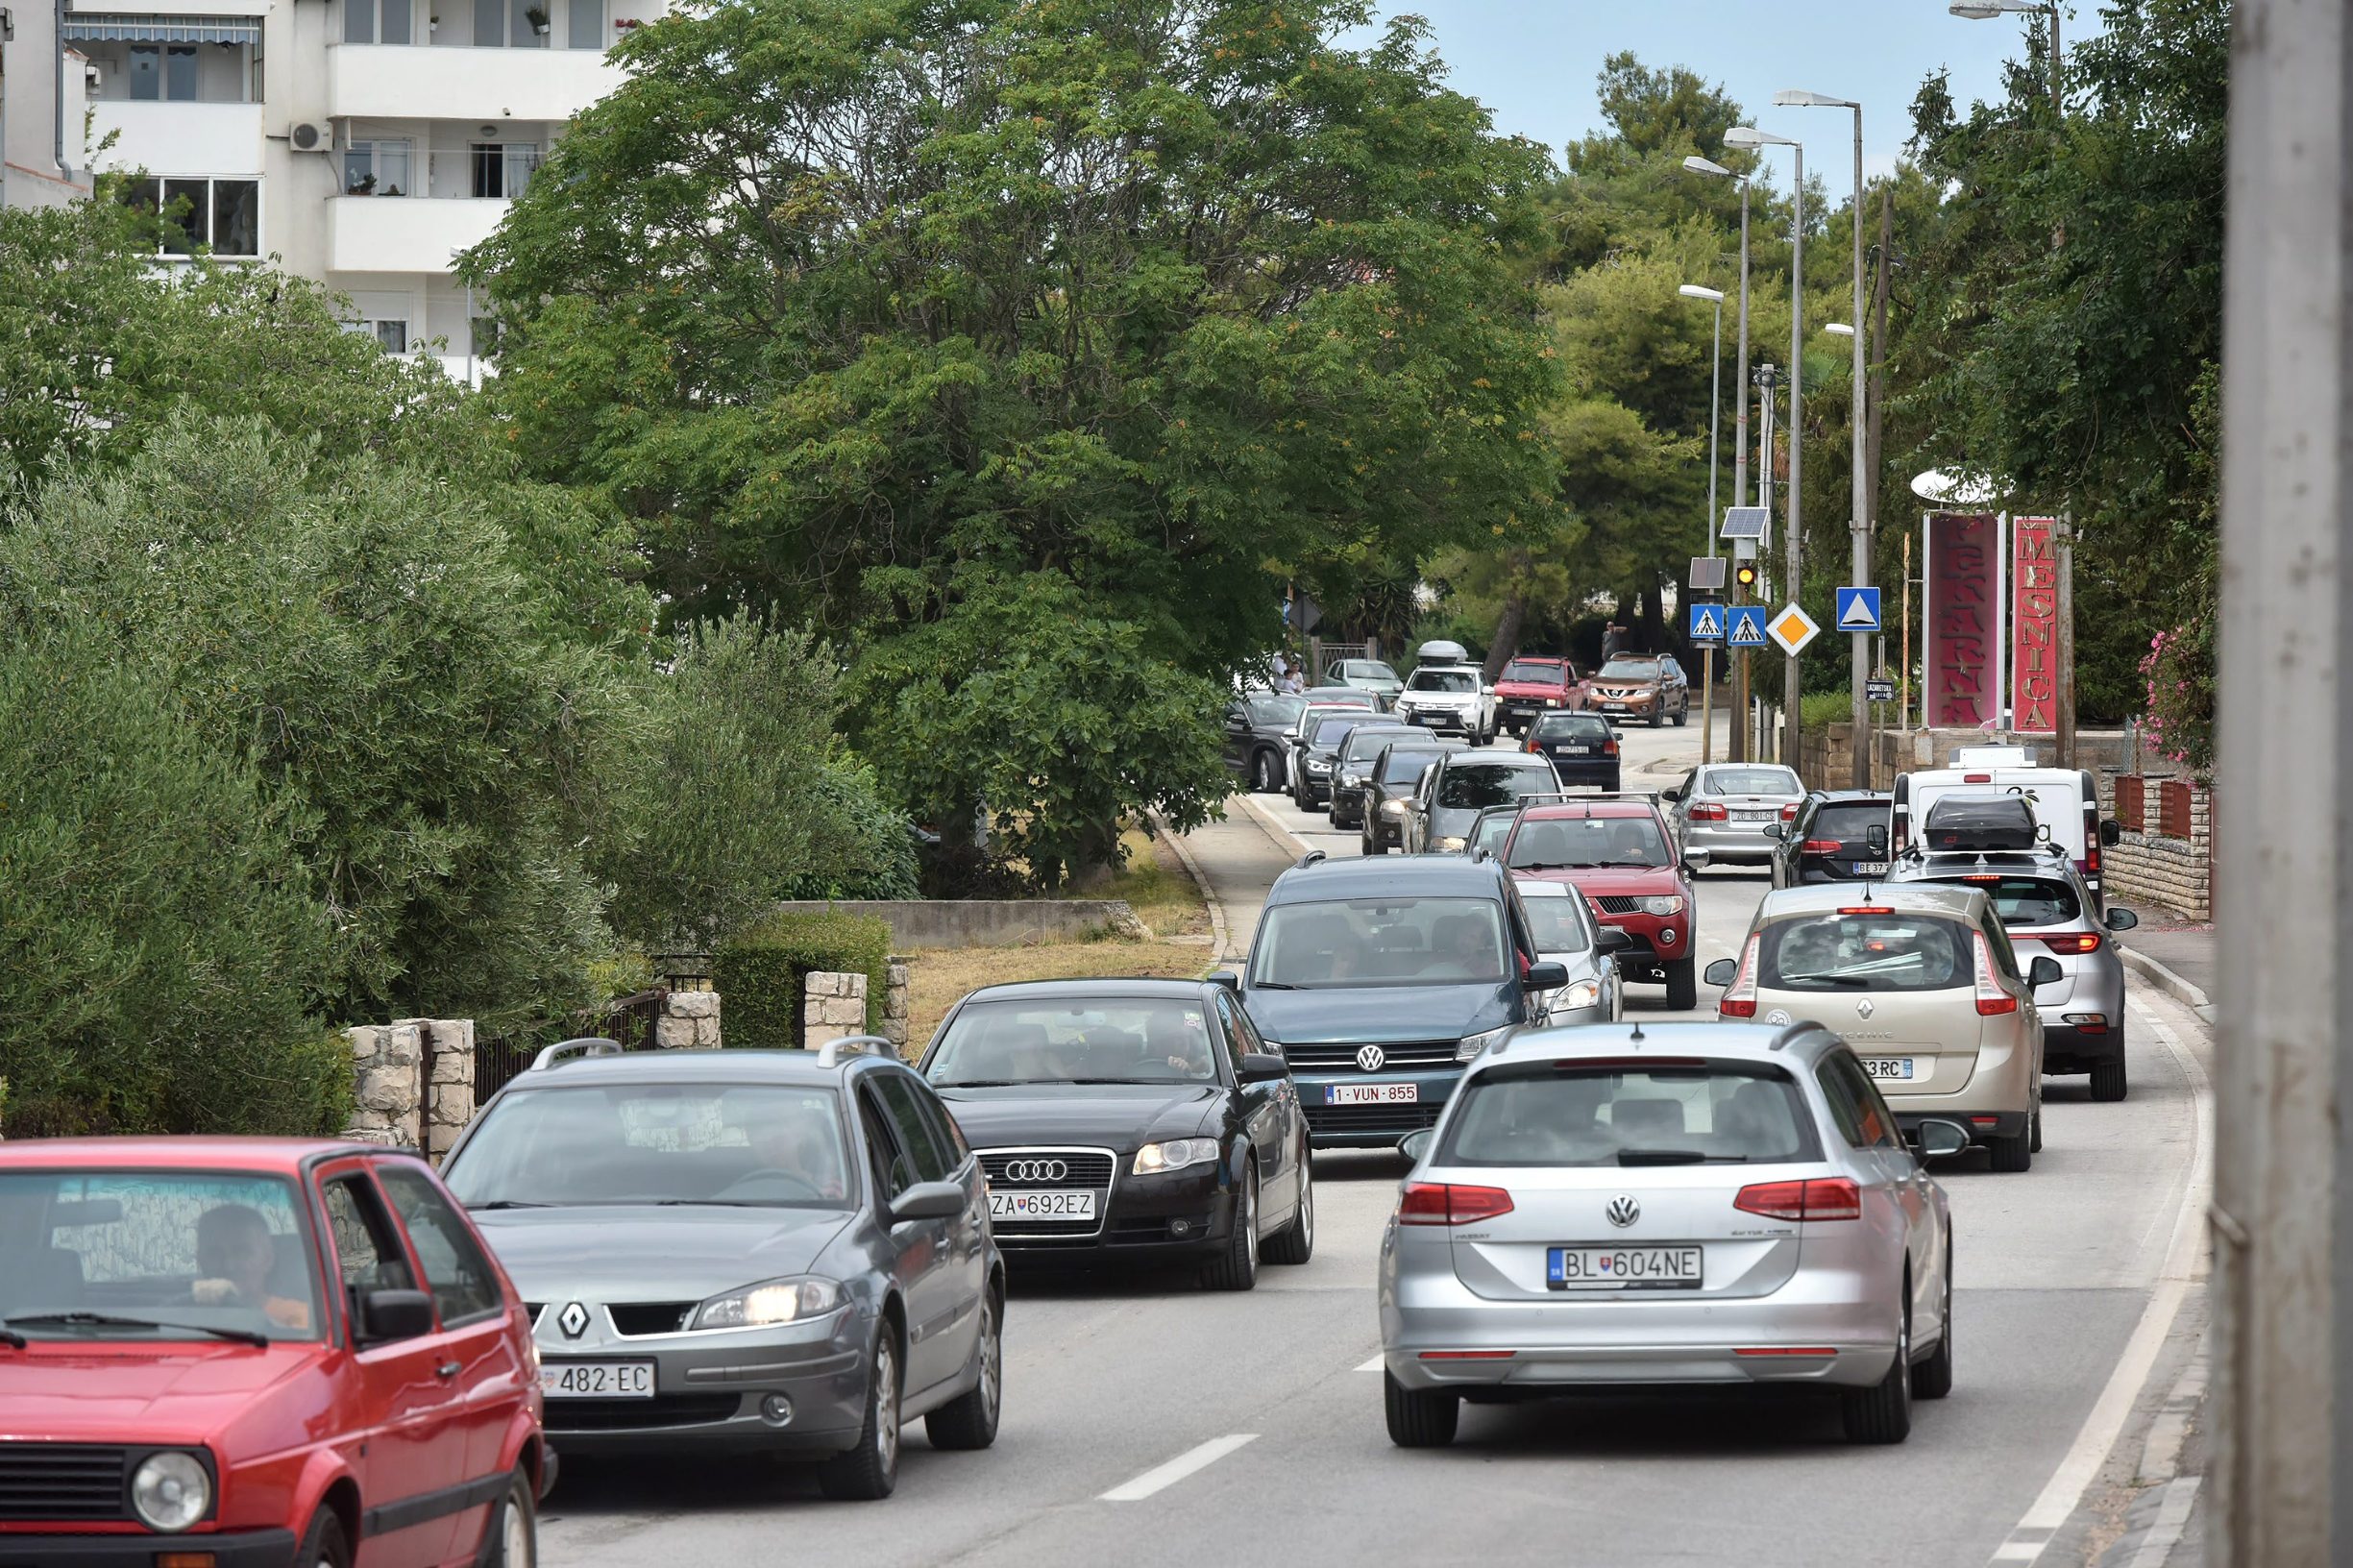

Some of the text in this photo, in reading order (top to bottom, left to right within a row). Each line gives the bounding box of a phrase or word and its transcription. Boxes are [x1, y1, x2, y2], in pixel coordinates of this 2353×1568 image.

[2018, 534, 2056, 729] MESNICA
[1836, 1031, 1895, 1040] SCENIC
[560, 1366, 648, 1392] 482-EC
